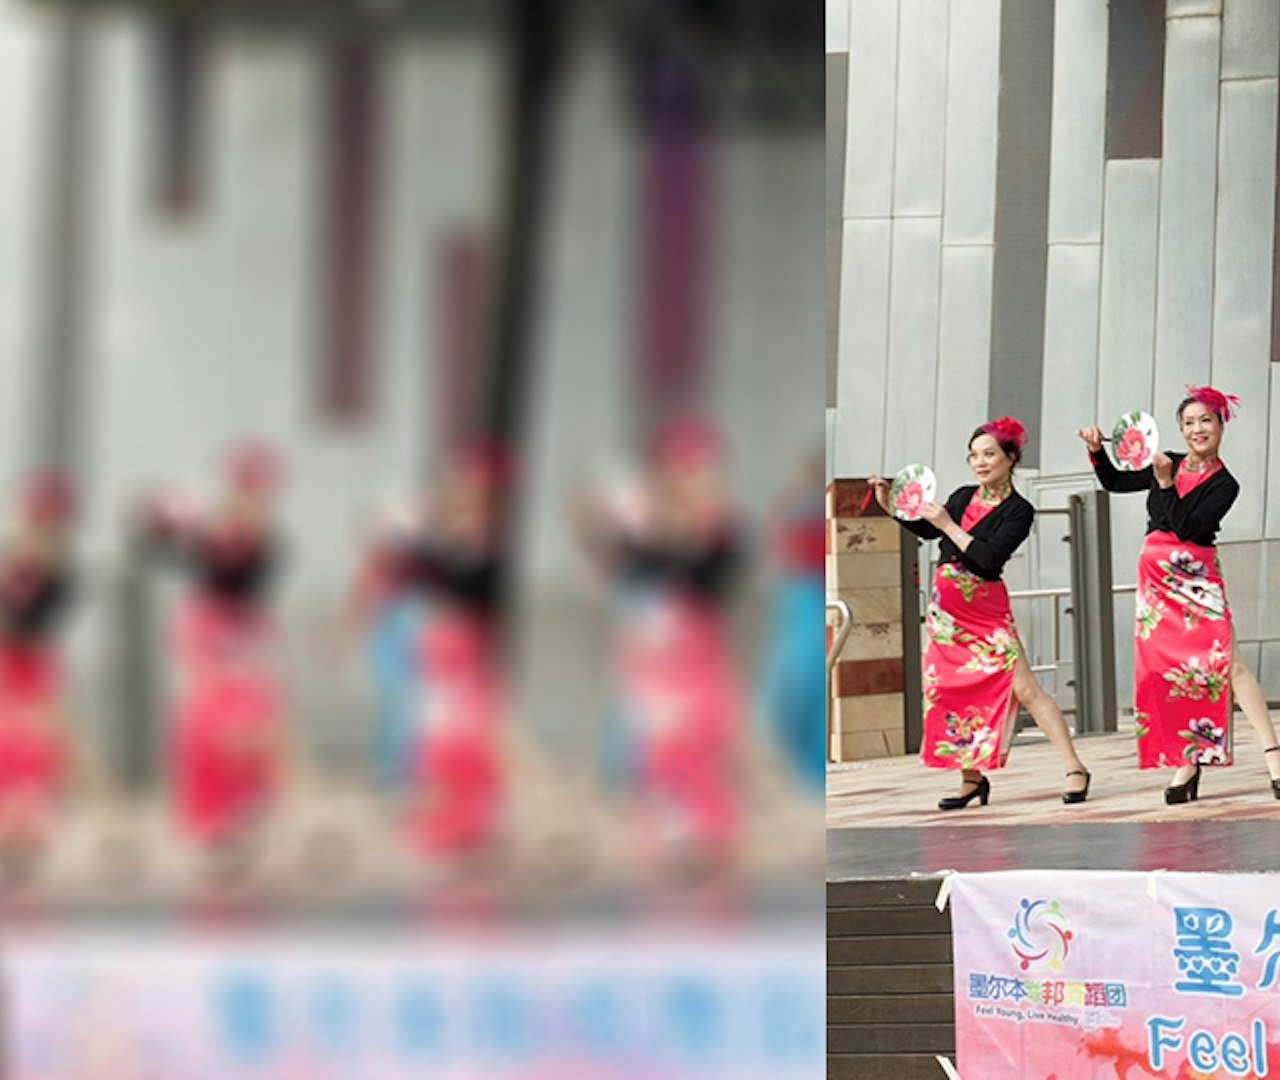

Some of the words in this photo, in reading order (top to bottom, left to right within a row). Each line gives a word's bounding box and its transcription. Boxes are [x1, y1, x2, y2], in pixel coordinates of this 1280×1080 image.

[969, 973, 1127, 1007] 墨尔本邦蹈团
[975, 1005, 994, 1014] Feel
[1027, 1010, 1045, 1020] Live
[1147, 1017, 1265, 1074] Feel
